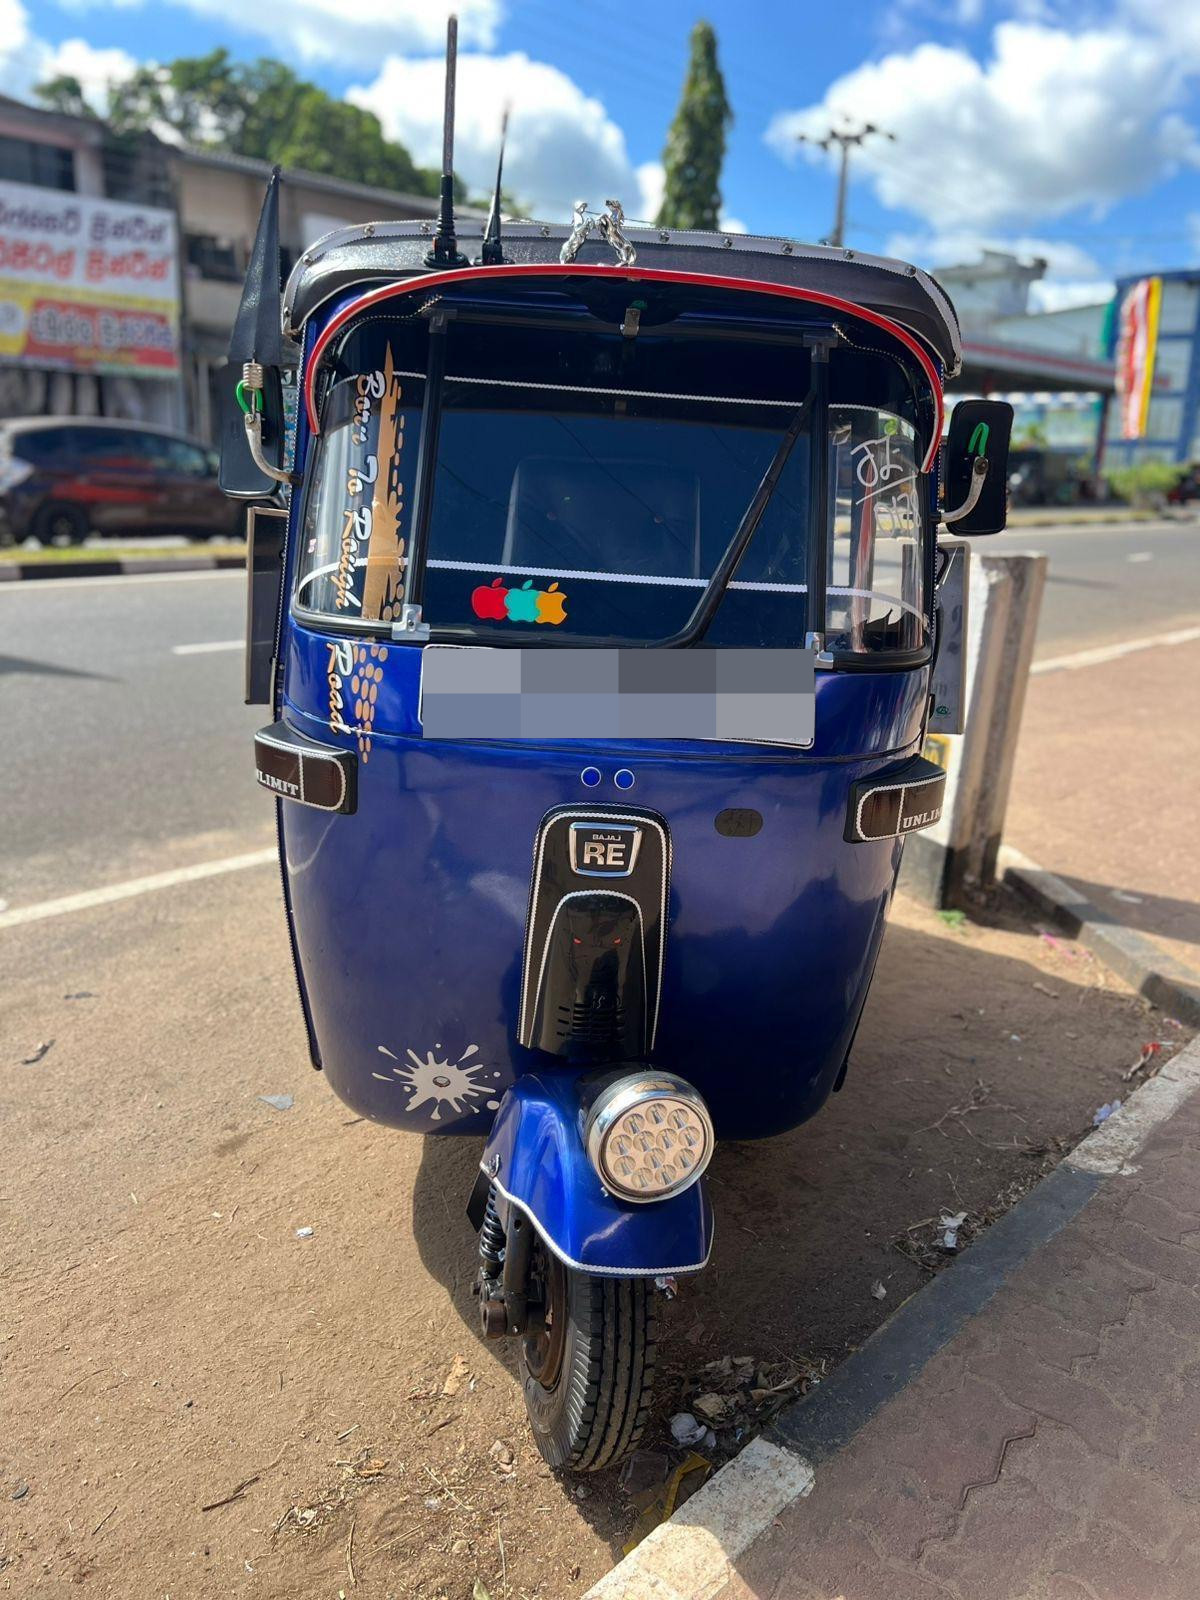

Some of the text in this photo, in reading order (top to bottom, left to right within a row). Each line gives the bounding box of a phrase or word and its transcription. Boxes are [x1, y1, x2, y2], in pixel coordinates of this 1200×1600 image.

[346, 454, 379, 498] To
[330, 506, 372, 610] Rough
[326, 639, 355, 735] Road
[256, 768, 299, 796] LIMIT
[583, 841, 626, 865] RE
[592, 833, 622, 841] BAJAJ
